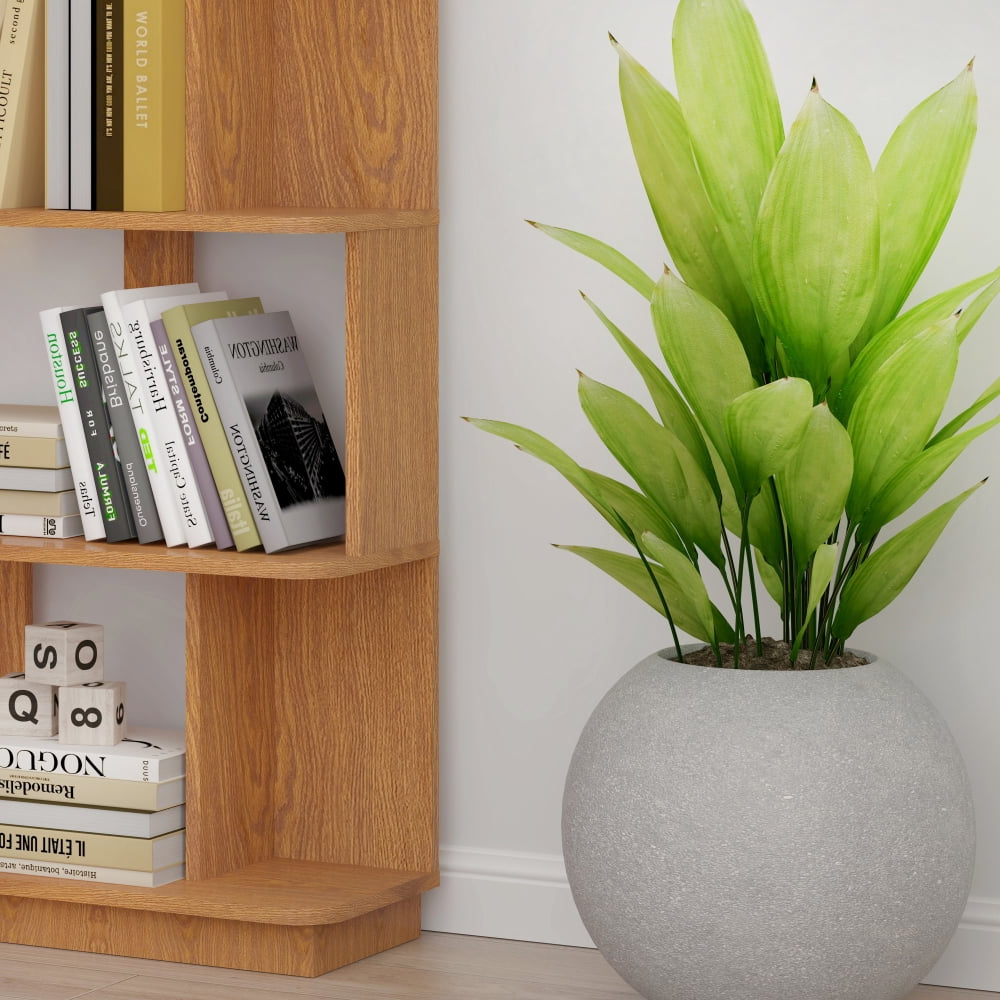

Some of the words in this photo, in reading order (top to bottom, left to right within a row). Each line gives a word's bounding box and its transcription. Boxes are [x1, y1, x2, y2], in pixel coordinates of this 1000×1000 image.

[10, 7, 21, 44] second
[135, 10, 148, 68] WORLD
[135, 75, 148, 129] BALLET
[33, 643, 58, 670] S
[8, 689, 39, 725] Q
[70, 707, 103, 728] 8
[16, 834, 38, 852] UNE
[41, 836, 73, 859] ÉTAIT
[75, 840, 86, 857] IL
[0, 861, 17, 870] arts
[20, 863, 60, 875] botanique,
[62, 867, 97, 879] Histoire,
